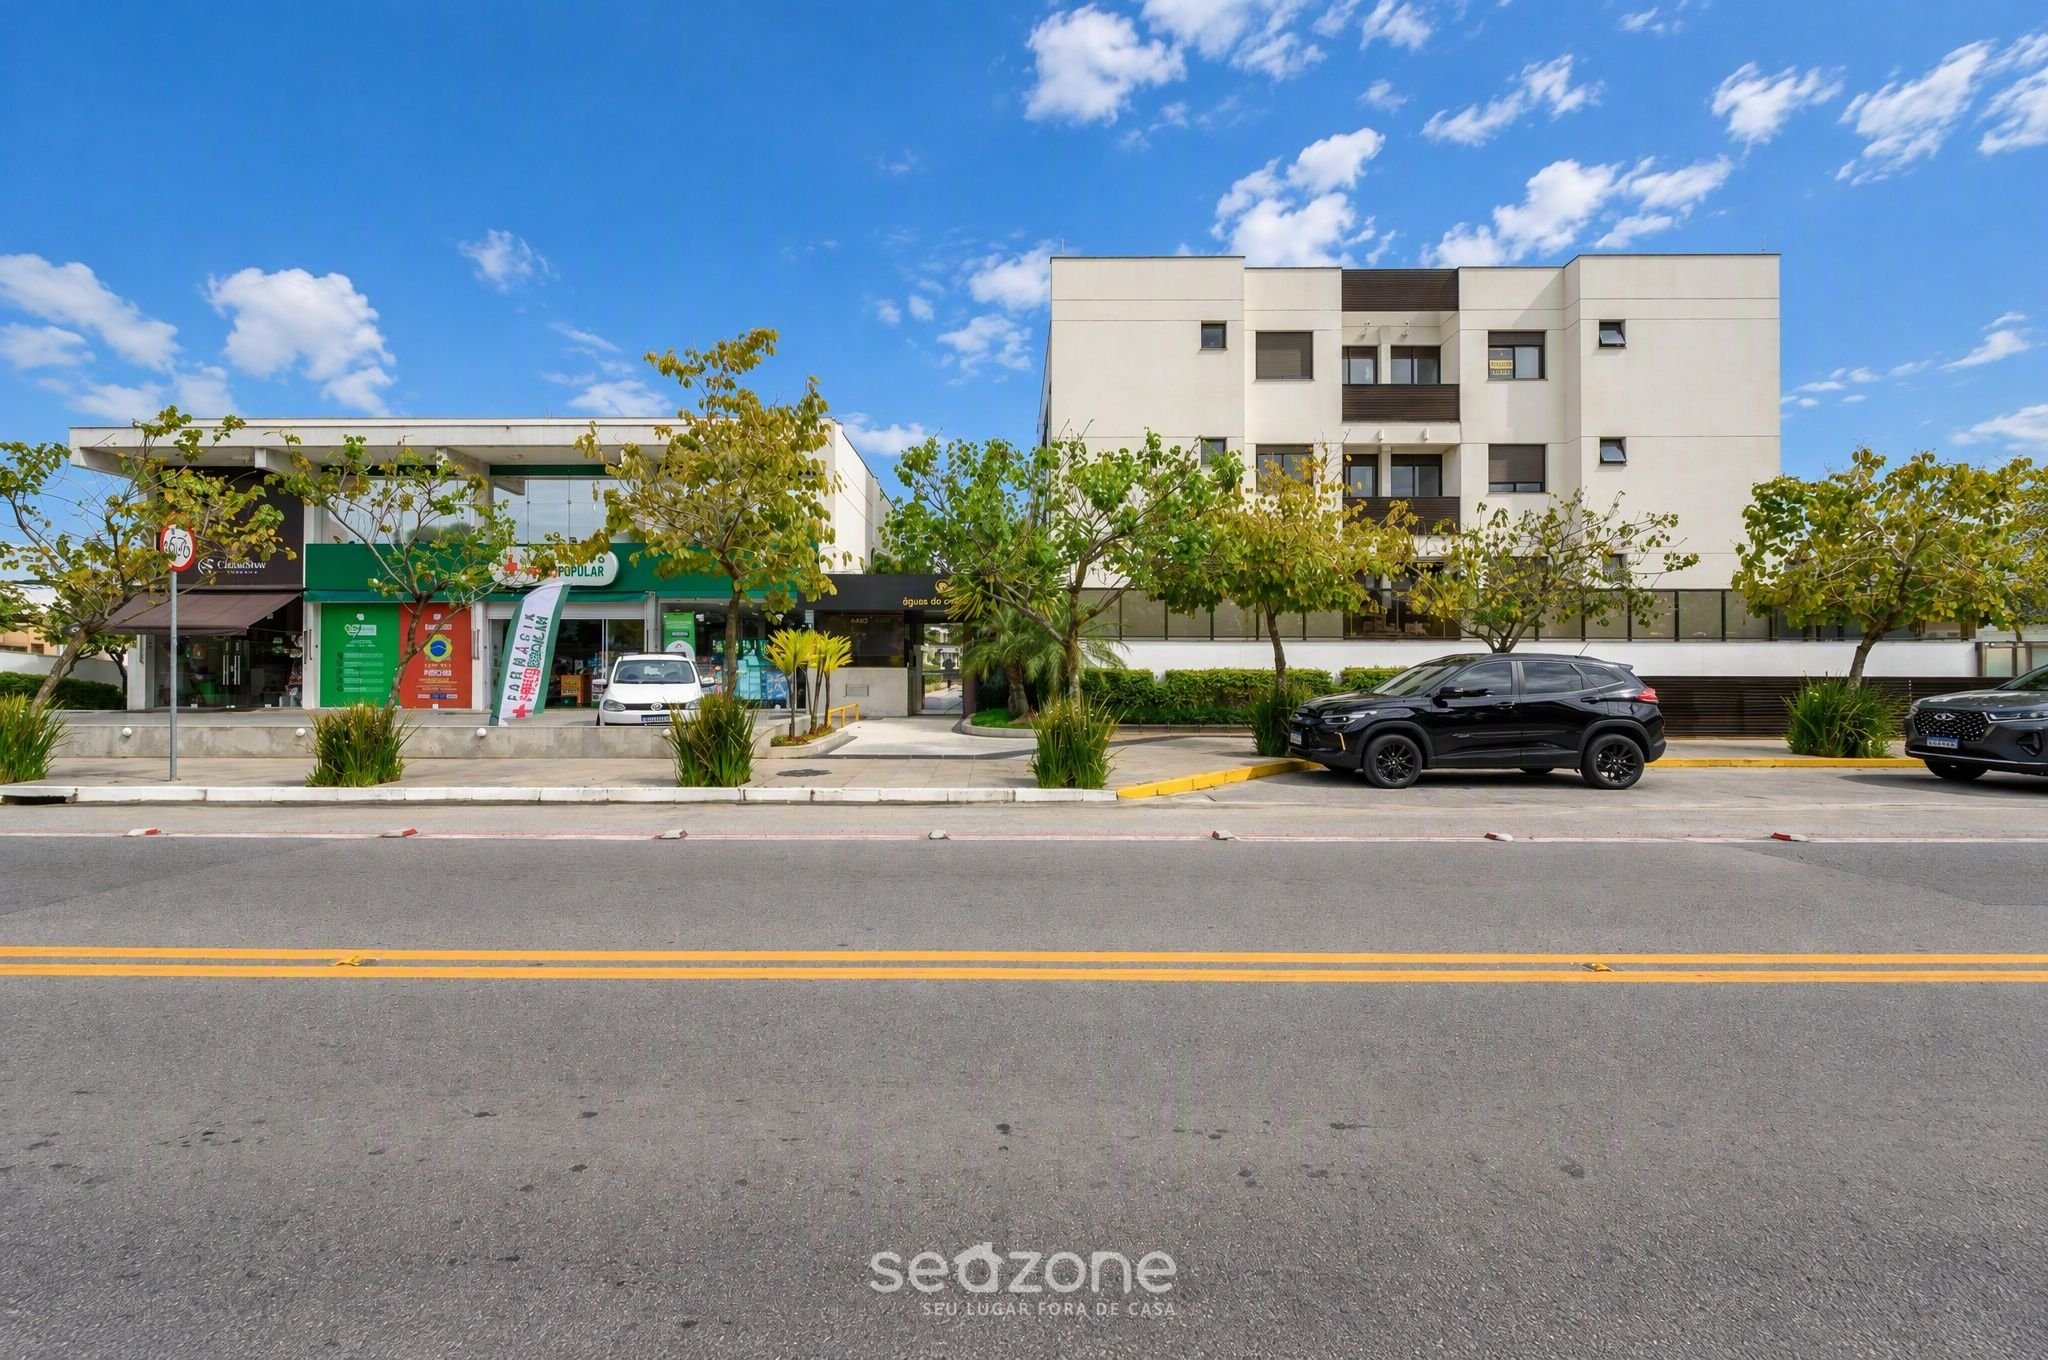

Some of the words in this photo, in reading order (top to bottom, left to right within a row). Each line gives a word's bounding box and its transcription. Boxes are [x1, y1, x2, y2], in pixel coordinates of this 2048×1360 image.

[557, 565, 604, 577] POPULAR
[902, 596, 928, 608] águas
[930, 596, 942, 605] do
